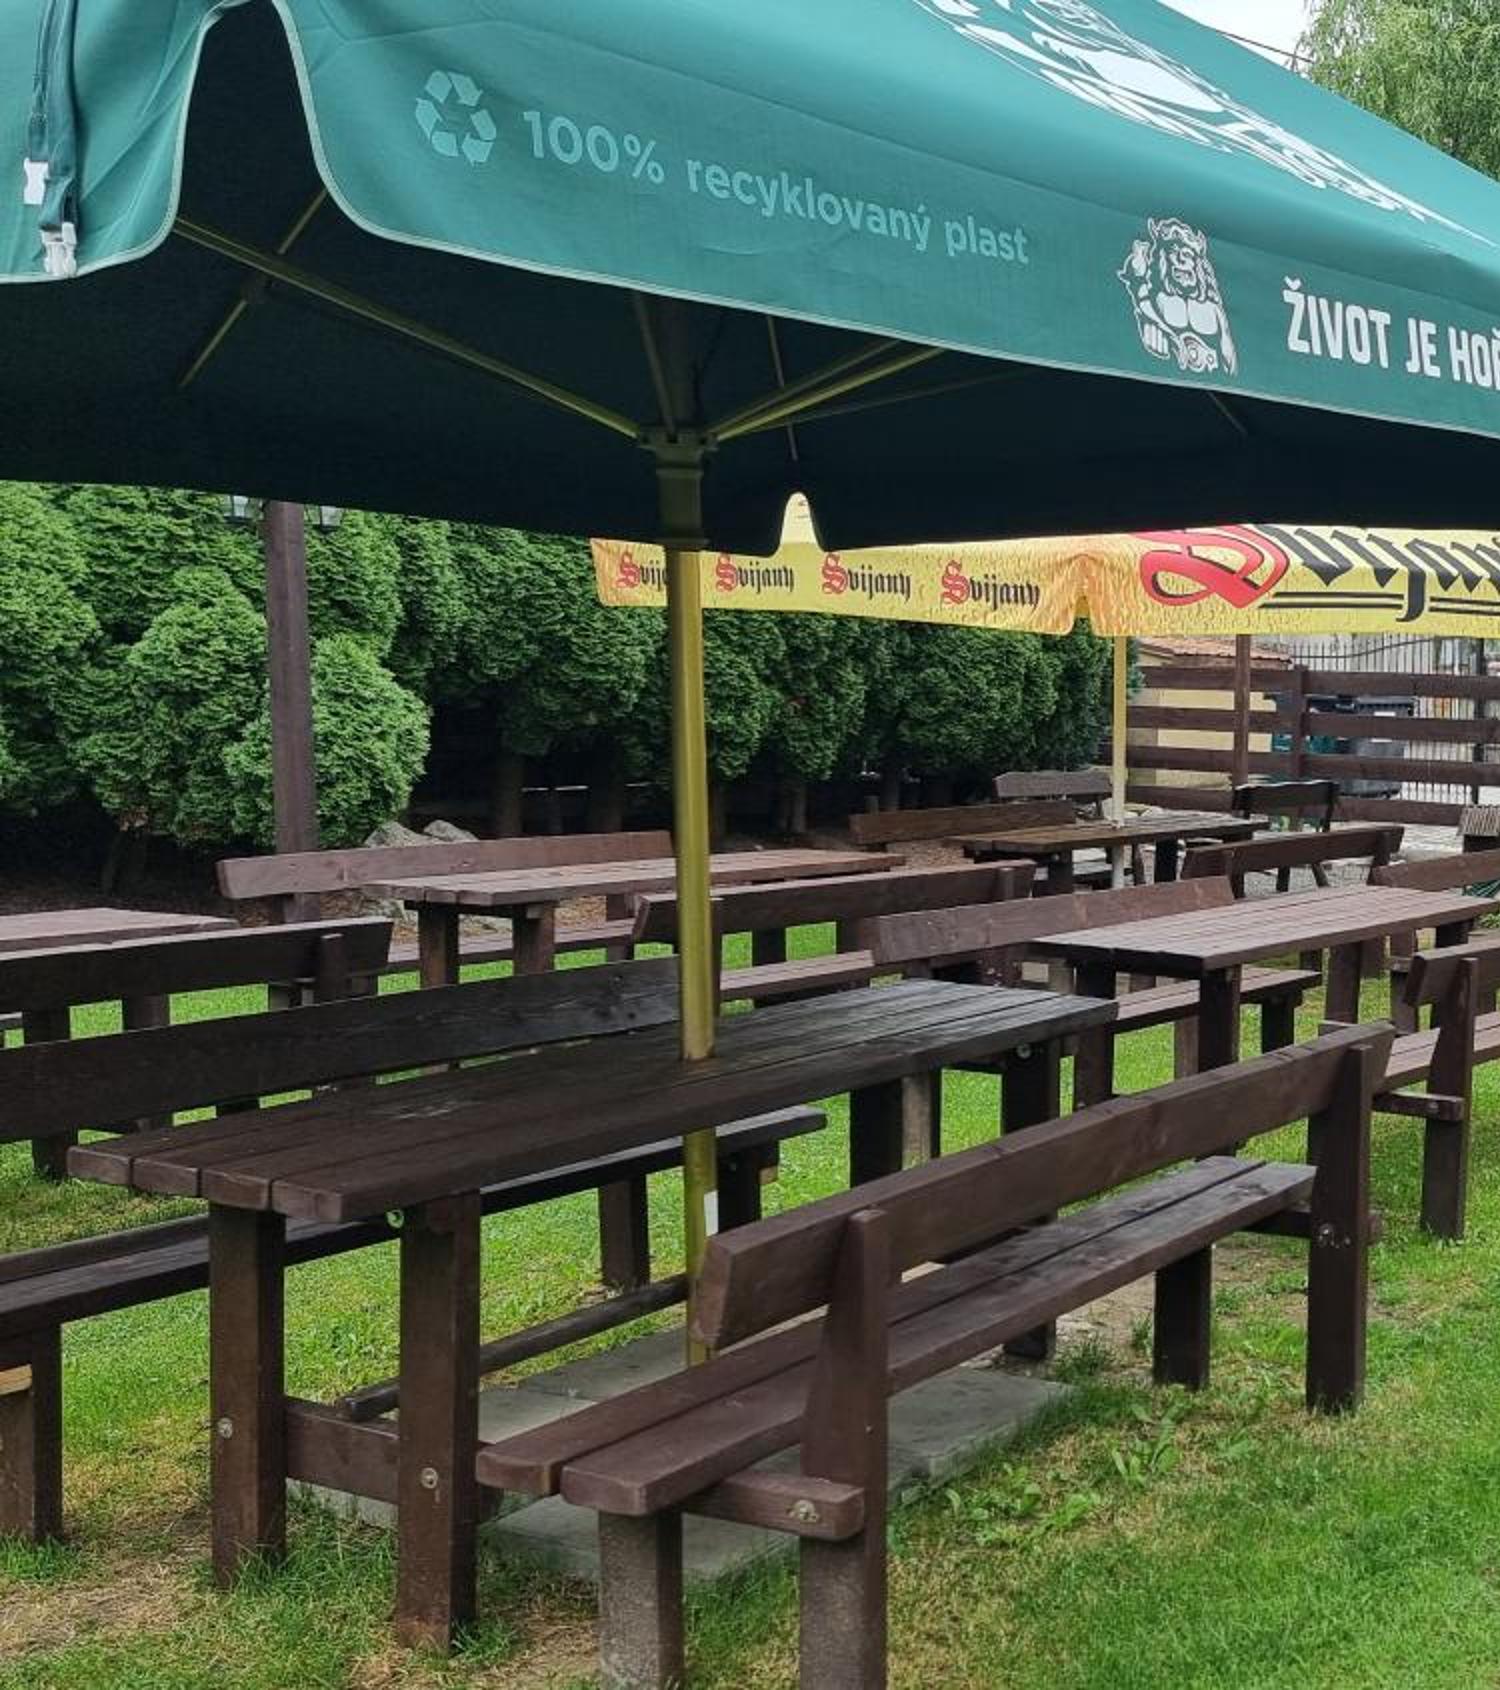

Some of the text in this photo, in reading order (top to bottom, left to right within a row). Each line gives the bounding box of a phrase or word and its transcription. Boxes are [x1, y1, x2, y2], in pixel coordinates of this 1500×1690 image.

[523, 110, 1029, 264] 100% recyklovaný plast
[1282, 275, 1391, 368] ŽIVOT
[1405, 317, 1441, 378] JE
[715, 553, 795, 594] Svijany
[821, 551, 911, 600] Svijany
[940, 559, 1040, 610] Svijany
